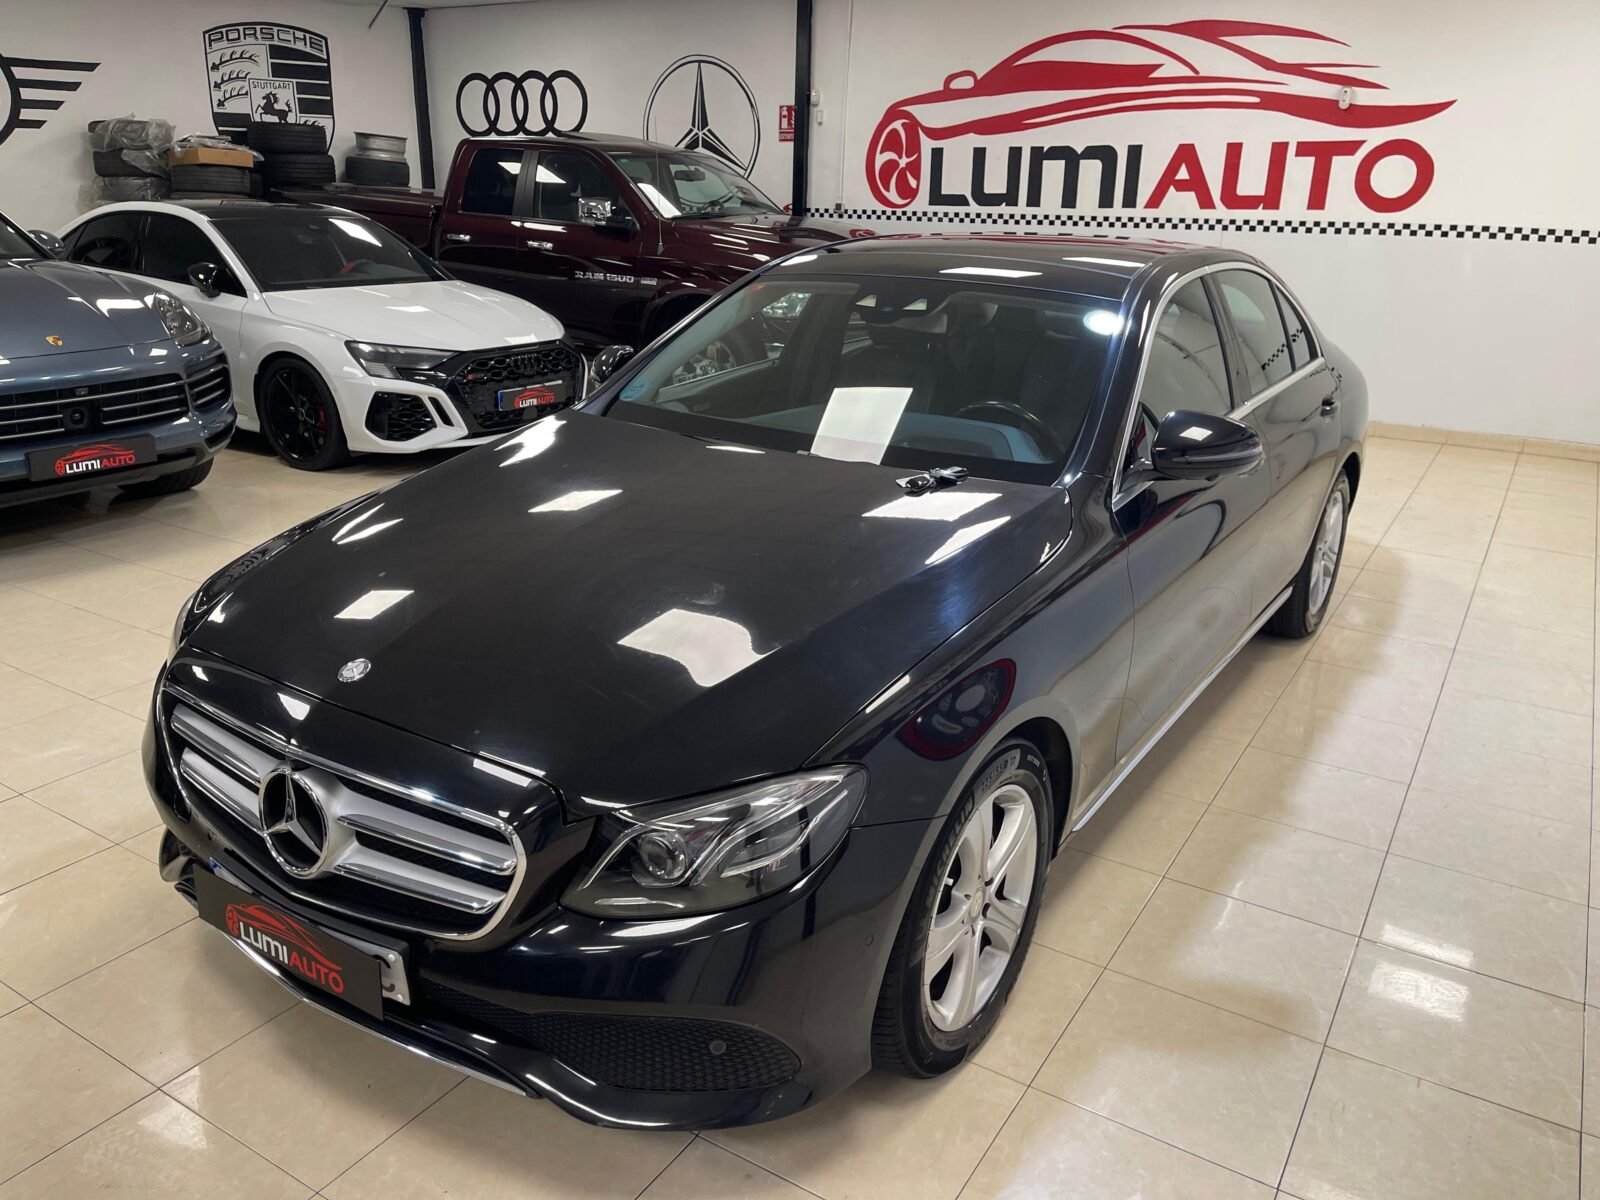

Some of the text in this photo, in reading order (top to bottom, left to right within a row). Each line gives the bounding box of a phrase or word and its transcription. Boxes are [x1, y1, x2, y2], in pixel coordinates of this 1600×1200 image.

[207, 26, 326, 54] PORSCHE
[251, 81, 291, 90] STUTTGART
[575, 270, 604, 280] RAM
[606, 273, 634, 283] 1500
